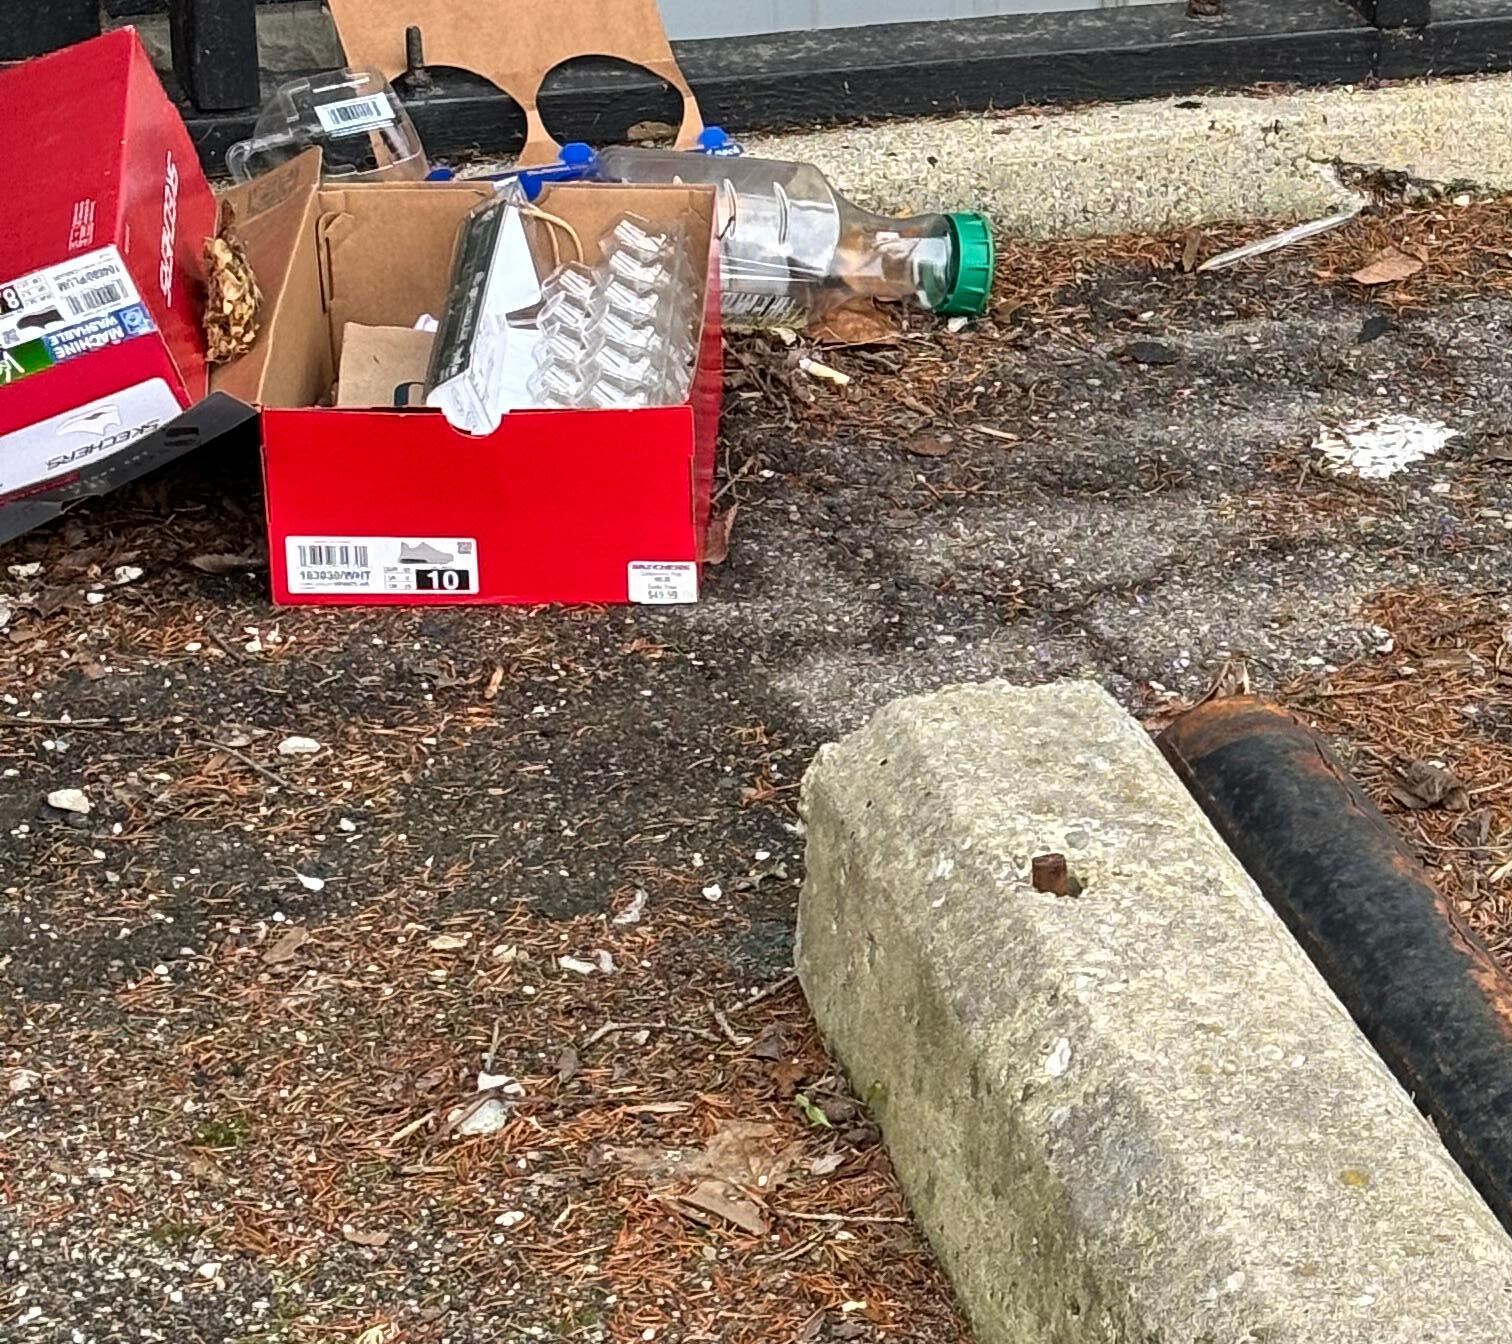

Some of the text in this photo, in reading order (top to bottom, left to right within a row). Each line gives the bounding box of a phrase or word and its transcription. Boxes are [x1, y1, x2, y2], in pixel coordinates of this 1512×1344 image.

[50, 314, 119, 346] WASHABLE
[54, 325, 126, 359] MACHINE
[45, 419, 160, 472] SKECHERS
[426, 570, 460, 591] 10
